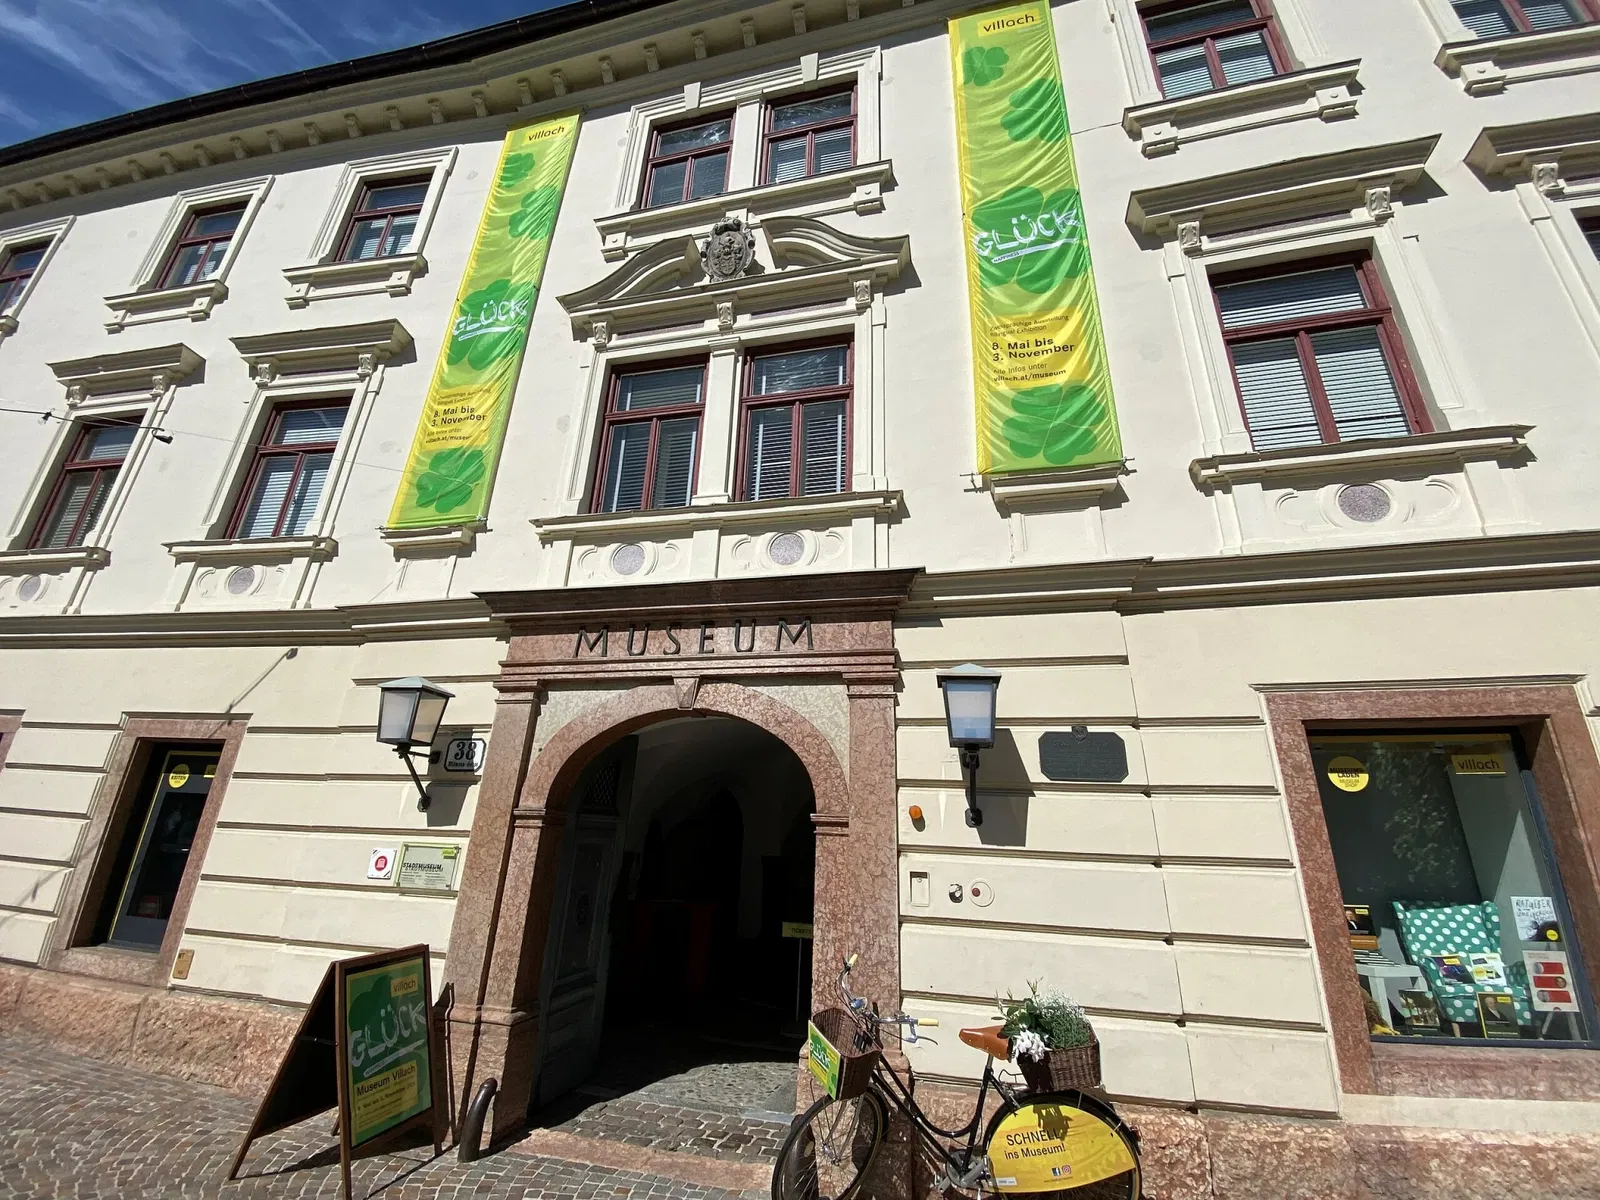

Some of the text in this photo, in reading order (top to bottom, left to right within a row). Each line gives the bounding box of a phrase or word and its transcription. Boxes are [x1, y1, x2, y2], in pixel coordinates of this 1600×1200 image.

[983, 14, 1035, 32] villach
[528, 126, 565, 141] villach
[973, 208, 1081, 257] GLÜCK
[992, 337, 1054, 351] 8. Mai bis
[992, 343, 1075, 362] 3. November
[993, 368, 1067, 382] villach.at/museum
[1008, 364, 1026, 374] Infos
[1028, 362, 1048, 371] unter
[442, 406, 458, 416] Mai
[460, 405, 475, 414] bis
[431, 419, 438, 427] 3.
[573, 616, 815, 659] MUSEUM
[453, 741, 477, 761] 38
[1457, 758, 1500, 770] villach
[392, 979, 417, 994] villach
[350, 1000, 427, 1067] GLÜCK
[356, 1076, 390, 1097] Museum
[391, 1064, 416, 1081] Villach
[1006, 1128, 1062, 1146] SCHNELL
[1004, 1142, 1067, 1160] ins Museum!
